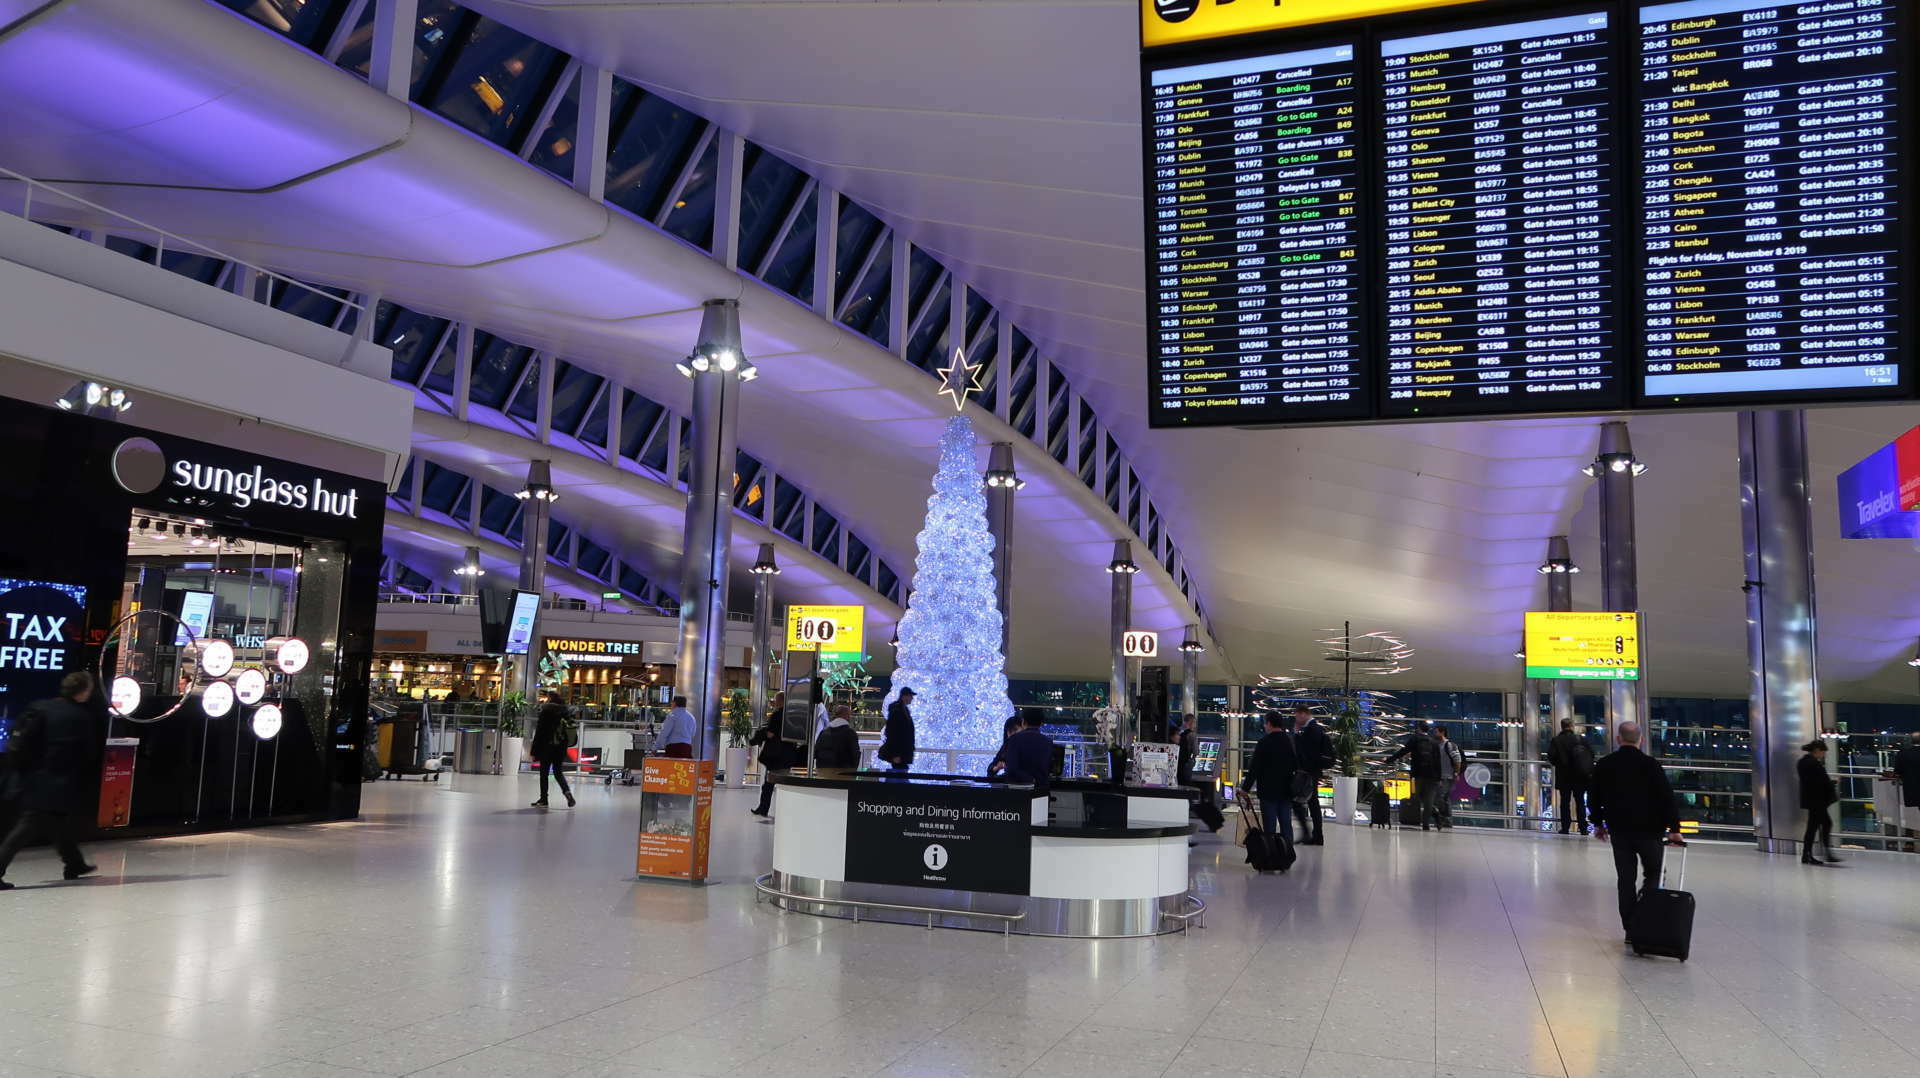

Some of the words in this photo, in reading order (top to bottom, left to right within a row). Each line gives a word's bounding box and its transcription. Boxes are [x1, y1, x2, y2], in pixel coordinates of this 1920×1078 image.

[1643, 23, 1667, 34] 20:45
[1671, 18, 1716, 30] Edinburgh
[1643, 39, 1667, 50] 20:45
[1671, 36, 1700, 46] Dublin
[1409, 52, 1449, 63] Stockholm
[1472, 44, 1503, 55] SK1524
[1643, 55, 1667, 65] 21:05
[1671, 50, 1716, 61] Stockholm
[1643, 70, 1668, 81] 21:20
[1671, 67, 1698, 77] Taipei
[1797, 54, 1822, 63] Gate
[1821, 50, 1855, 60] shown
[1855, 45, 1883, 56] 20:10
[1409, 68, 1438, 77] Munich
[1176, 83, 1202, 92] Munich
[1275, 67, 1312, 80] Cancelled
[1410, 83, 1445, 92] Hamburg
[1672, 85, 1687, 93] via:
[1689, 79, 1728, 91] Bangkok
[1177, 98, 1202, 106] Geneva
[1276, 84, 1310, 94] Boarding
[1336, 77, 1351, 86] A17
[1410, 95, 1450, 107] Dusseldorf
[1643, 101, 1668, 112] 21:30
[1672, 99, 1695, 108] Delhi
[1177, 110, 1209, 120] Frankfurt
[1276, 114, 1288, 122] Go
[1299, 111, 1317, 119] Gate
[1337, 106, 1352, 114] A24
[1410, 111, 1446, 121] Frankfurt
[1644, 117, 1669, 127] 21:35
[1672, 113, 1710, 124] Bangkok
[1743, 105, 1773, 116] TG917
[1410, 127, 1439, 136] Geneva
[1644, 132, 1669, 142] 21:40
[1673, 130, 1704, 139] Bogota
[1178, 139, 1202, 147] Beijing
[1411, 142, 1428, 151] Oslo
[1644, 148, 1669, 158] 21:40
[1673, 145, 1715, 154] Shenzhen
[1178, 152, 1201, 161] Dublin
[1411, 156, 1445, 165] Shannon
[1644, 163, 1670, 173] 22:00
[1673, 161, 1693, 170] Cork
[1798, 150, 1822, 158] Gate
[1823, 147, 1856, 156] shown
[1856, 142, 1884, 153] 21:10
[1179, 165, 1206, 174] Istanbul
[1645, 178, 1669, 189] 22:05
[1673, 175, 1712, 185] Chengdu
[1744, 168, 1775, 179] CA424
[1179, 179, 1204, 188] Munich
[1412, 185, 1437, 194] Dublin
[1179, 193, 1205, 202] Brussels
[1645, 194, 1670, 204] 22:05
[1673, 192, 1717, 201] Singapore
[1412, 200, 1438, 209] Belfast
[1439, 199, 1455, 207] City
[1645, 209, 1670, 219] 22:15
[1673, 208, 1704, 216] Athens
[1412, 214, 1451, 223] Stavanger
[1180, 221, 1206, 229] Newark
[1646, 225, 1670, 235] 22:30
[1674, 223, 1697, 232] Cairo
[1180, 234, 1213, 242] Aberdeen
[1413, 230, 1437, 238] Lisbon
[1413, 244, 1445, 252] Cologne
[1646, 240, 1670, 250] 22:35
[1674, 238, 1708, 247] Istanbul
[1648, 255, 1678, 266] Flights
[1678, 254, 1693, 262] for
[1694, 252, 1725, 262] Friday,
[1726, 248, 1774, 259] November
[1783, 245, 1807, 255] 2019
[1181, 261, 1228, 270] Johannesburg
[1413, 258, 1437, 267] Zurich
[1413, 273, 1435, 281] Seoul
[1675, 269, 1701, 278] Zurich
[1181, 275, 1217, 284] Stockholm
[1414, 287, 1436, 295] Addis
[1436, 286, 1462, 294] Ababa
[1675, 300, 1703, 308] Lisbon
[1799, 293, 1823, 301] Gate
[1824, 291, 1856, 300] shown
[1857, 288, 1884, 298] 05:15
[1182, 303, 1217, 311] Edinburgh
[1414, 302, 1443, 310] Munich
[1182, 317, 1214, 325] Frankfurt
[1414, 316, 1452, 324] Aberdeen
[1675, 315, 1715, 324] Frankfurt
[1414, 331, 1441, 340] Beijing
[1183, 345, 1213, 353] Stuttgart
[1415, 345, 1463, 354] Copenhagen
[1676, 345, 1720, 355] Edinburgh
[1183, 358, 1204, 366] Zurich
[1415, 359, 1451, 369] Reykjavik
[1675, 361, 1720, 370] Stockholm
[1183, 372, 1227, 380] Copenhagen
[1864, 367, 1891, 377] 16:51
[1415, 375, 1454, 383] Singapore
[1206, 398, 1238, 406] (Haneda)
[172, 460, 308, 509] sunglass
[311, 478, 359, 519] hut
[1857, 490, 1895, 526] Travelex
[6, 612, 67, 642] TAX
[546, 639, 640, 654] WONDERTREE
[0, 646, 65, 670] FREE
[645, 767, 660, 775] Give
[644, 776, 668, 786] Change
[857, 801, 903, 817] Shopping
[905, 804, 925, 816] and
[927, 805, 960, 821] Dining
[962, 808, 1021, 822] Information
[923, 874, 947, 882] Heathrow
